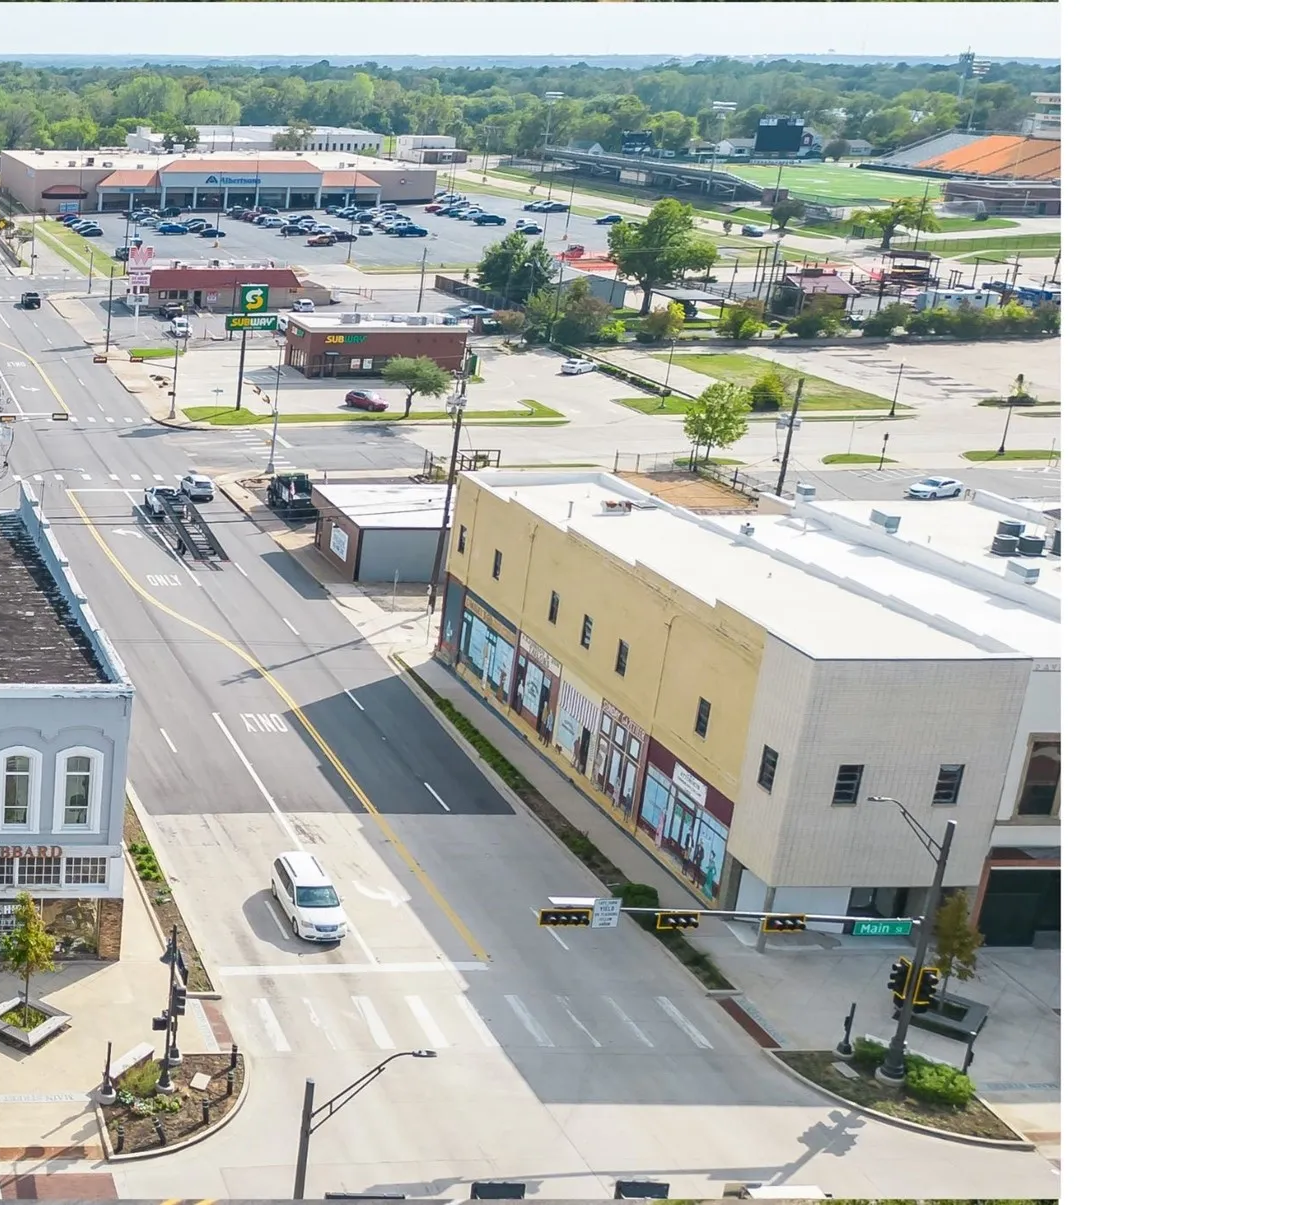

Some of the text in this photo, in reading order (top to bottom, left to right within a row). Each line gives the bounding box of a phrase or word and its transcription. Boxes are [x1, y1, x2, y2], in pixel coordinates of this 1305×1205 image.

[230, 316, 275, 327] SUBWAY
[325, 335, 368, 343] SUBWAY
[146, 574, 182, 587] ONLY
[239, 713, 289, 734] ONLY
[860, 923, 890, 934] Main
[45, 1093, 74, 1101] MAIN
